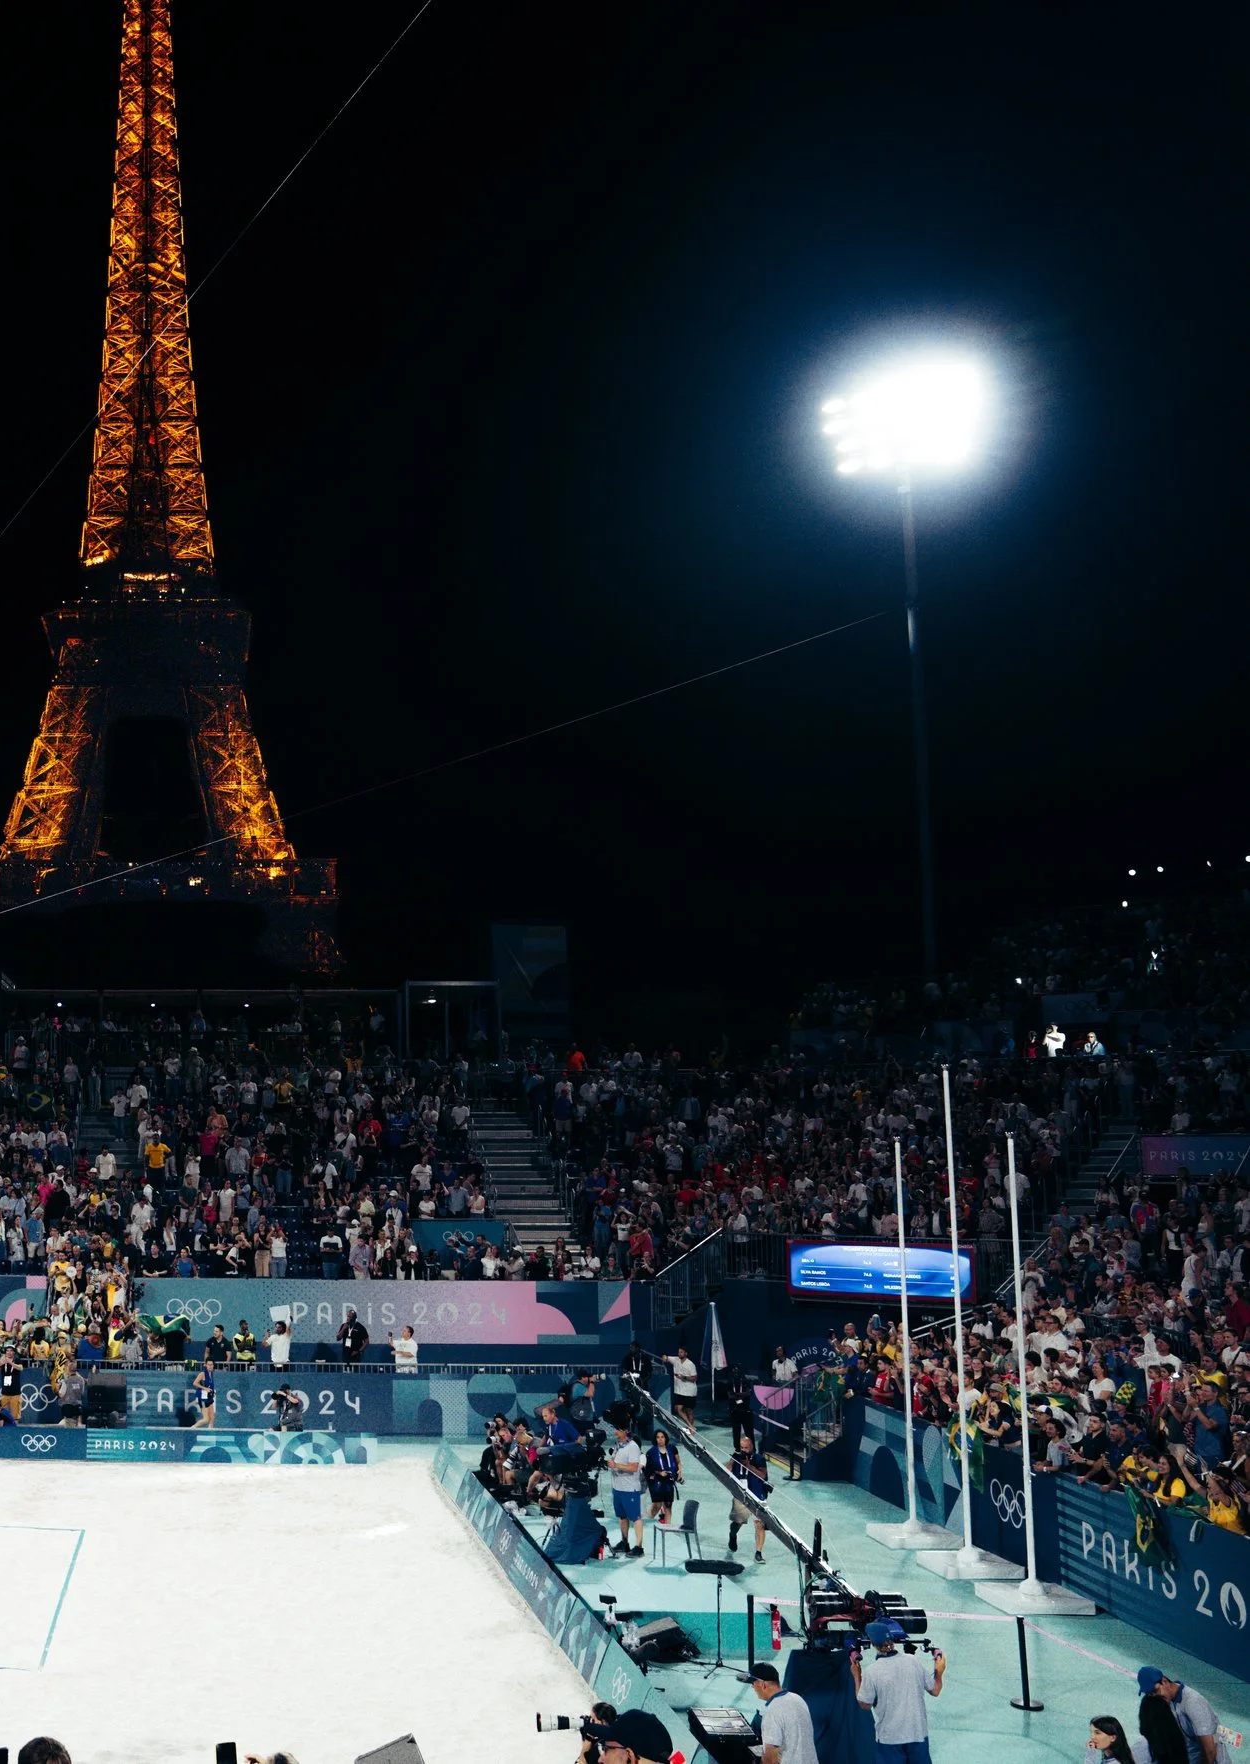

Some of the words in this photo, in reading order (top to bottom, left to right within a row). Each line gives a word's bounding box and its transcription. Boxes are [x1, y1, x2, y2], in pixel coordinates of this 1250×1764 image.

[413, 1302, 508, 1326] 2024
[822, 1347, 844, 1365] 202
[95, 1439, 135, 1450] PARIS
[139, 1440, 176, 1451] 2024
